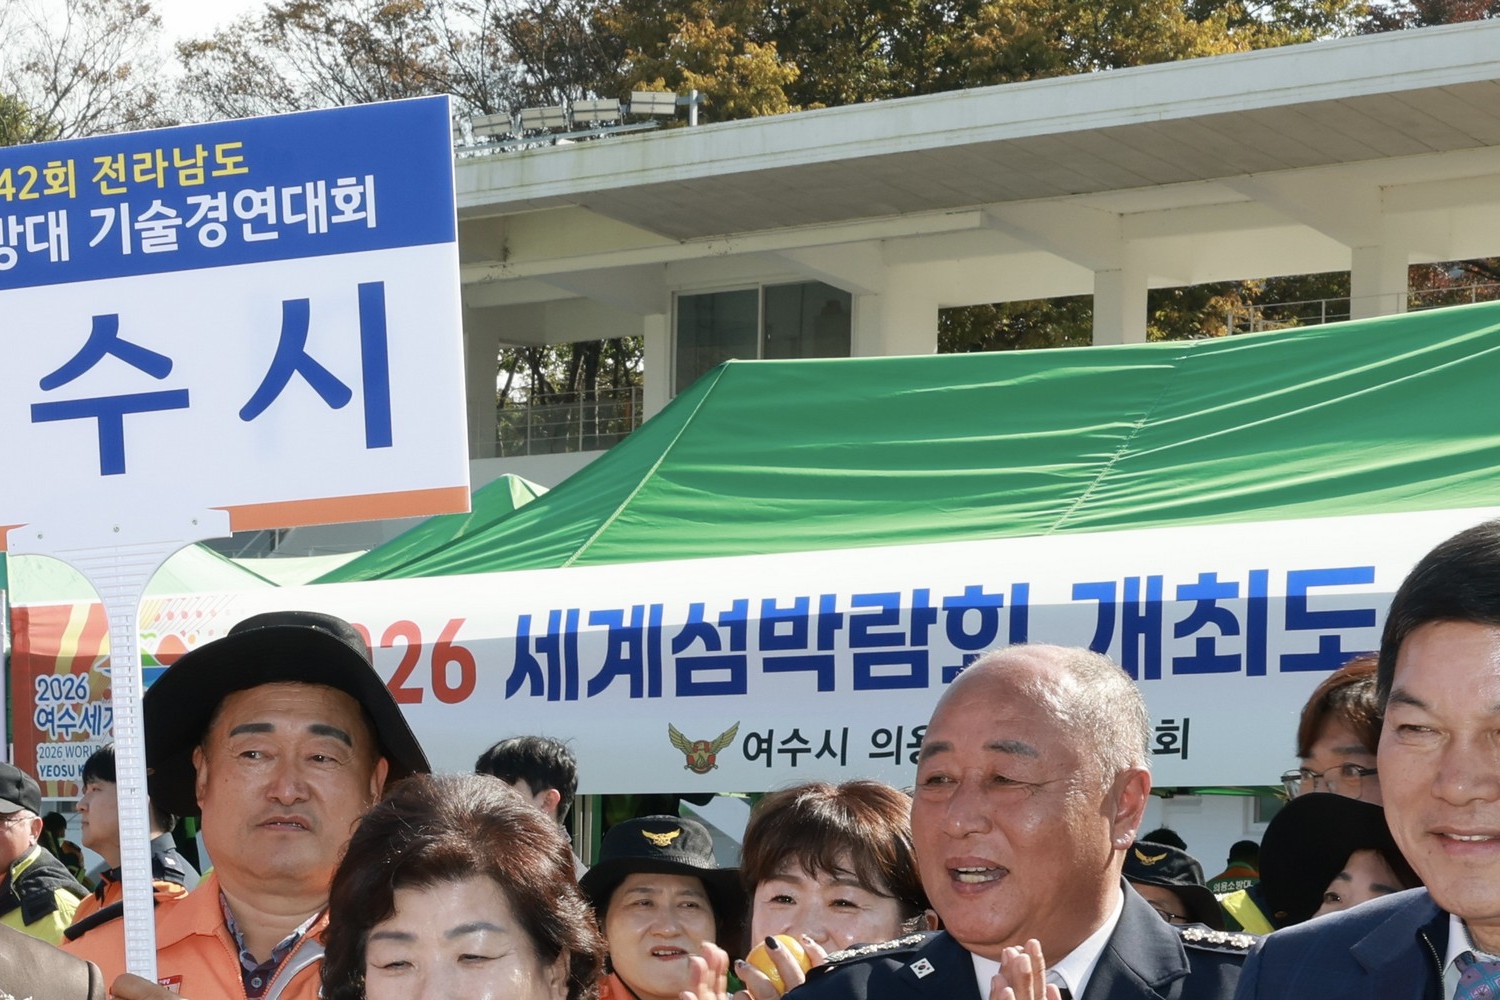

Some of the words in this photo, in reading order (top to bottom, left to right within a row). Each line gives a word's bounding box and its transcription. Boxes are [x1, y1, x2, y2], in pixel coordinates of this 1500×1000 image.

[92, 141, 250, 196] 전라남도
[89, 175, 378, 256] 기술경연대회
[505, 582, 1030, 702] 세계섬박람회
[37, 676, 88, 702] 2026
[39, 745, 63, 759] 2026
[742, 726, 849, 768] 여수시
[39, 764, 76, 777] YEOSU
